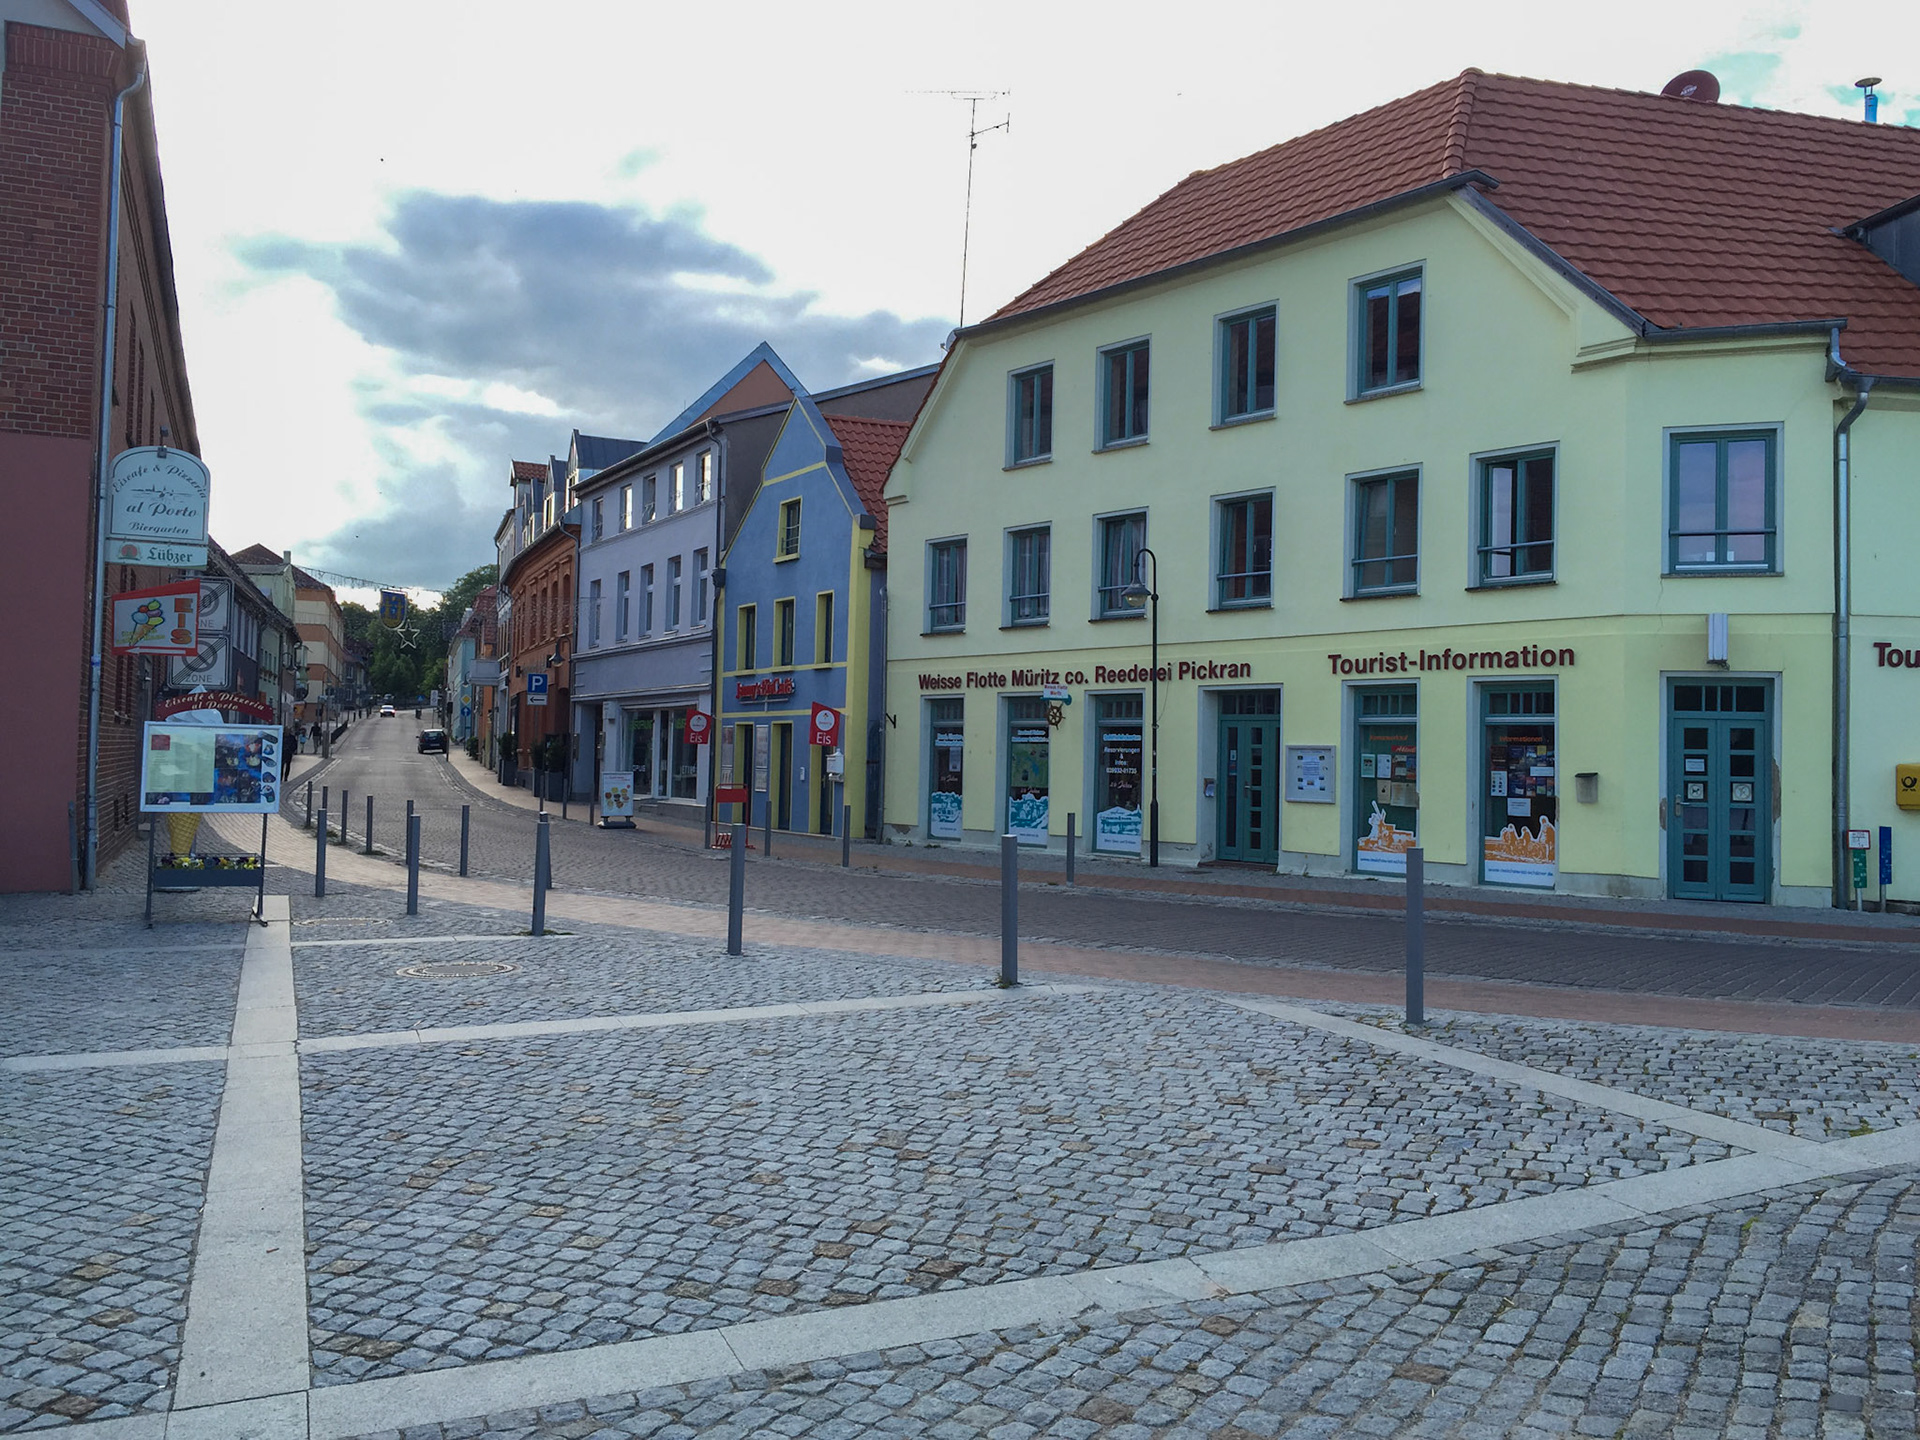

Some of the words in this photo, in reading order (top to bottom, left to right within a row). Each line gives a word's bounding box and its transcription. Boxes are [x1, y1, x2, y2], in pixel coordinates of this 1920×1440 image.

[153, 464, 160, 472] &
[165, 464, 207, 499] Pizzeria
[126, 502, 144, 513] al
[148, 502, 197, 517] Porto
[129, 522, 189, 534] Biergarten
[147, 547, 193, 563] Lübzer
[171, 598, 193, 645] EIS
[1328, 645, 1575, 675] Tourist-Information
[185, 674, 213, 683] ZONE
[918, 674, 962, 690] Weisse
[967, 672, 1006, 688] Flotte
[1012, 669, 1059, 686] Müritz
[1065, 671, 1089, 685] co.
[1095, 663, 1172, 683] Reederei
[1178, 660, 1251, 680] Pickran
[532, 676, 543, 691] P
[191, 701, 202, 710] al
[206, 701, 239, 710] Porto
[218, 692, 265, 711] Pizzeria
[690, 733, 702, 743] Eis
[816, 731, 831, 745] Eis
